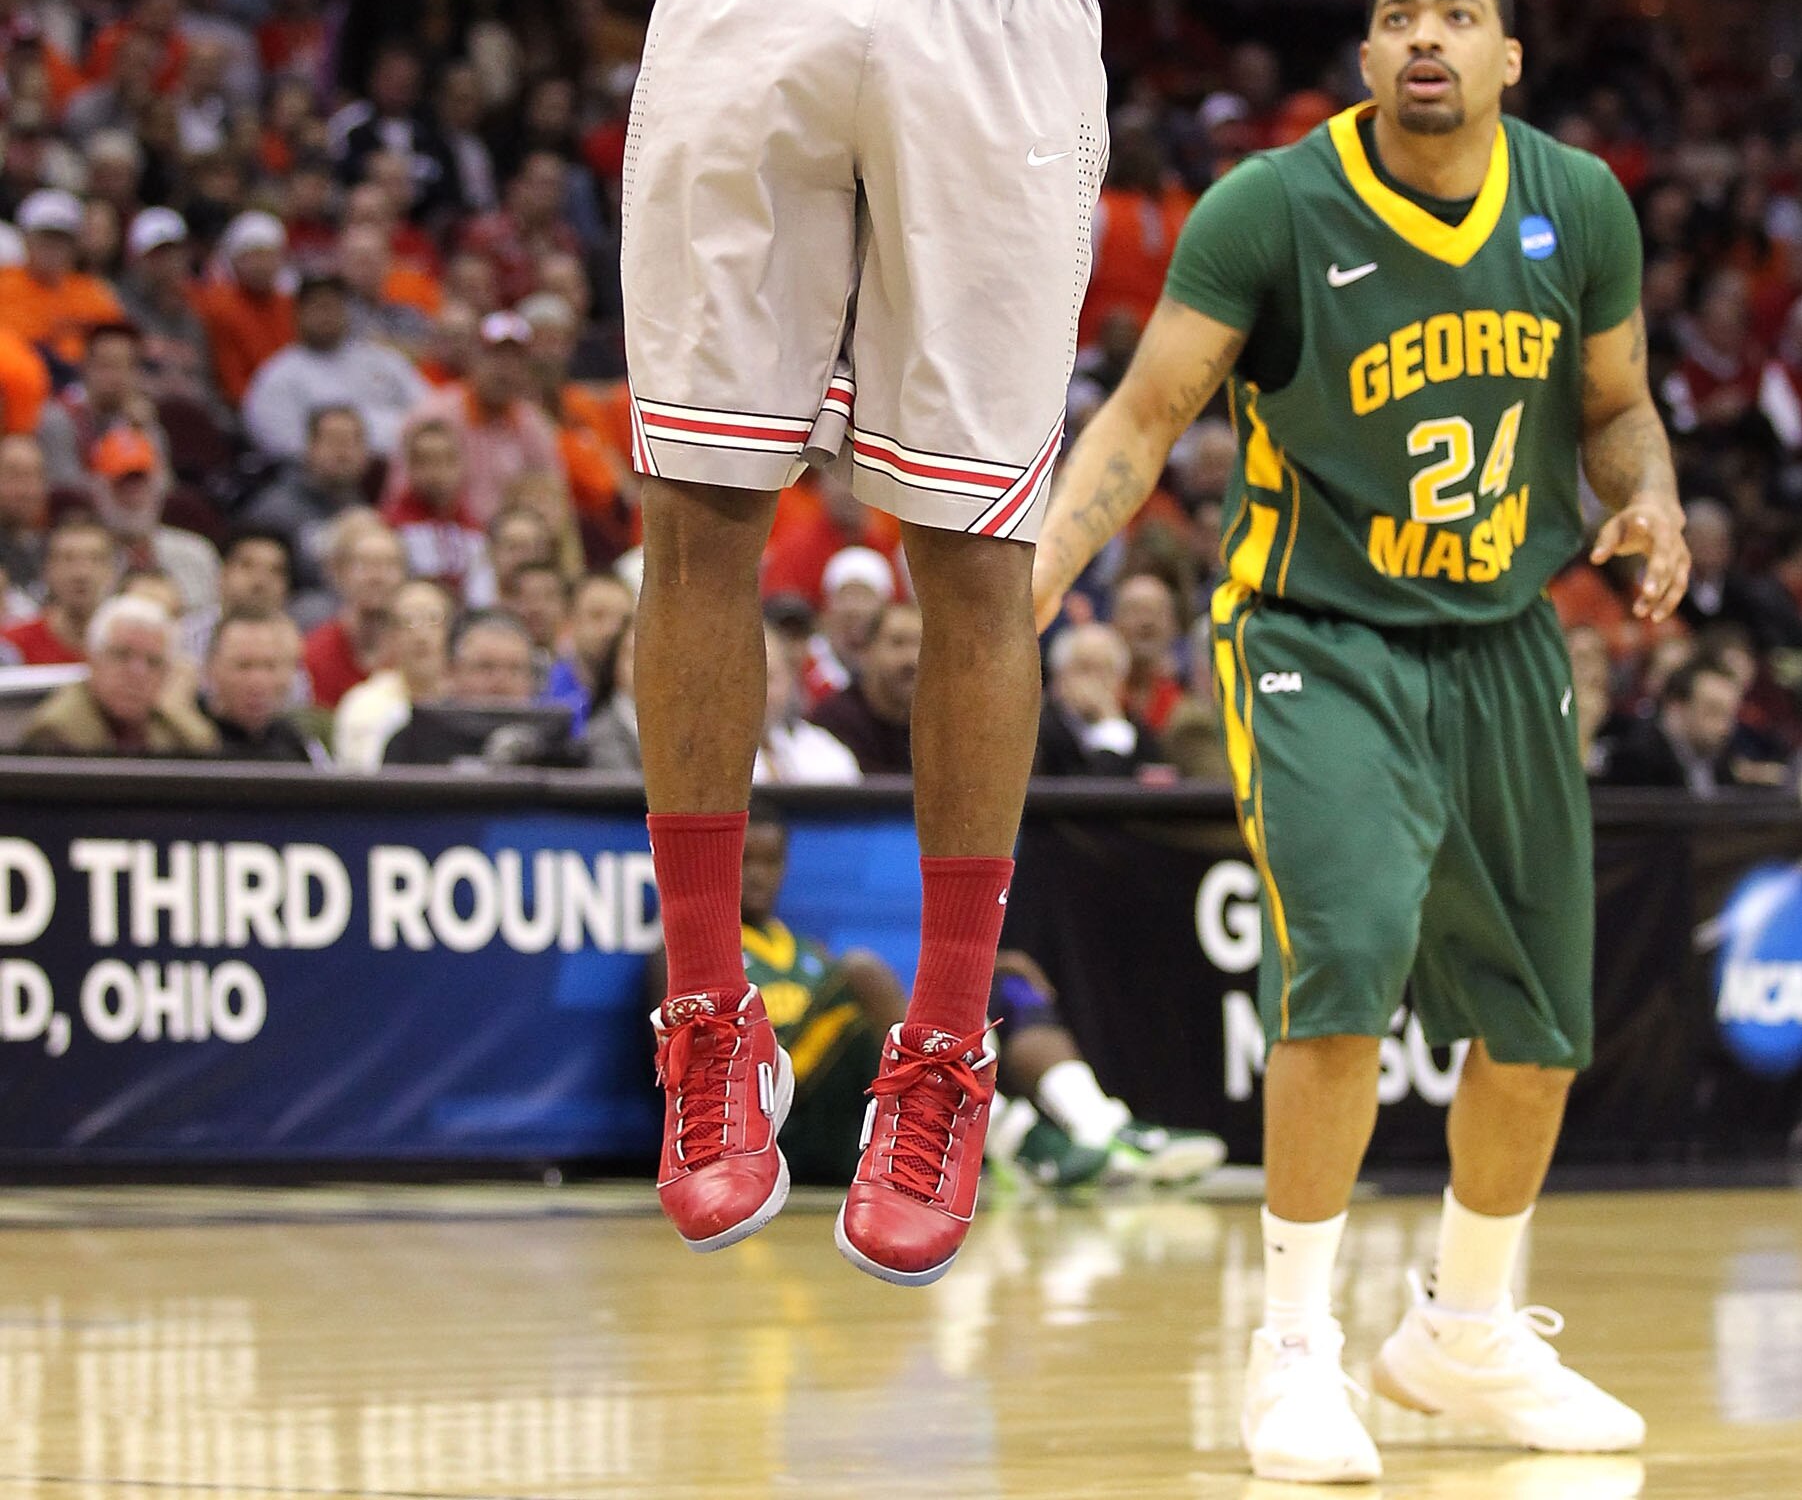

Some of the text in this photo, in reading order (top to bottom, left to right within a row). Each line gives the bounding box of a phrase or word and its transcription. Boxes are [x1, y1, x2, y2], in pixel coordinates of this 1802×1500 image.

[1406, 399, 1524, 525] 24
[68, 837, 354, 950] THIRD
[366, 844, 665, 954] ROUND
[79, 958, 268, 1045] OHIO
